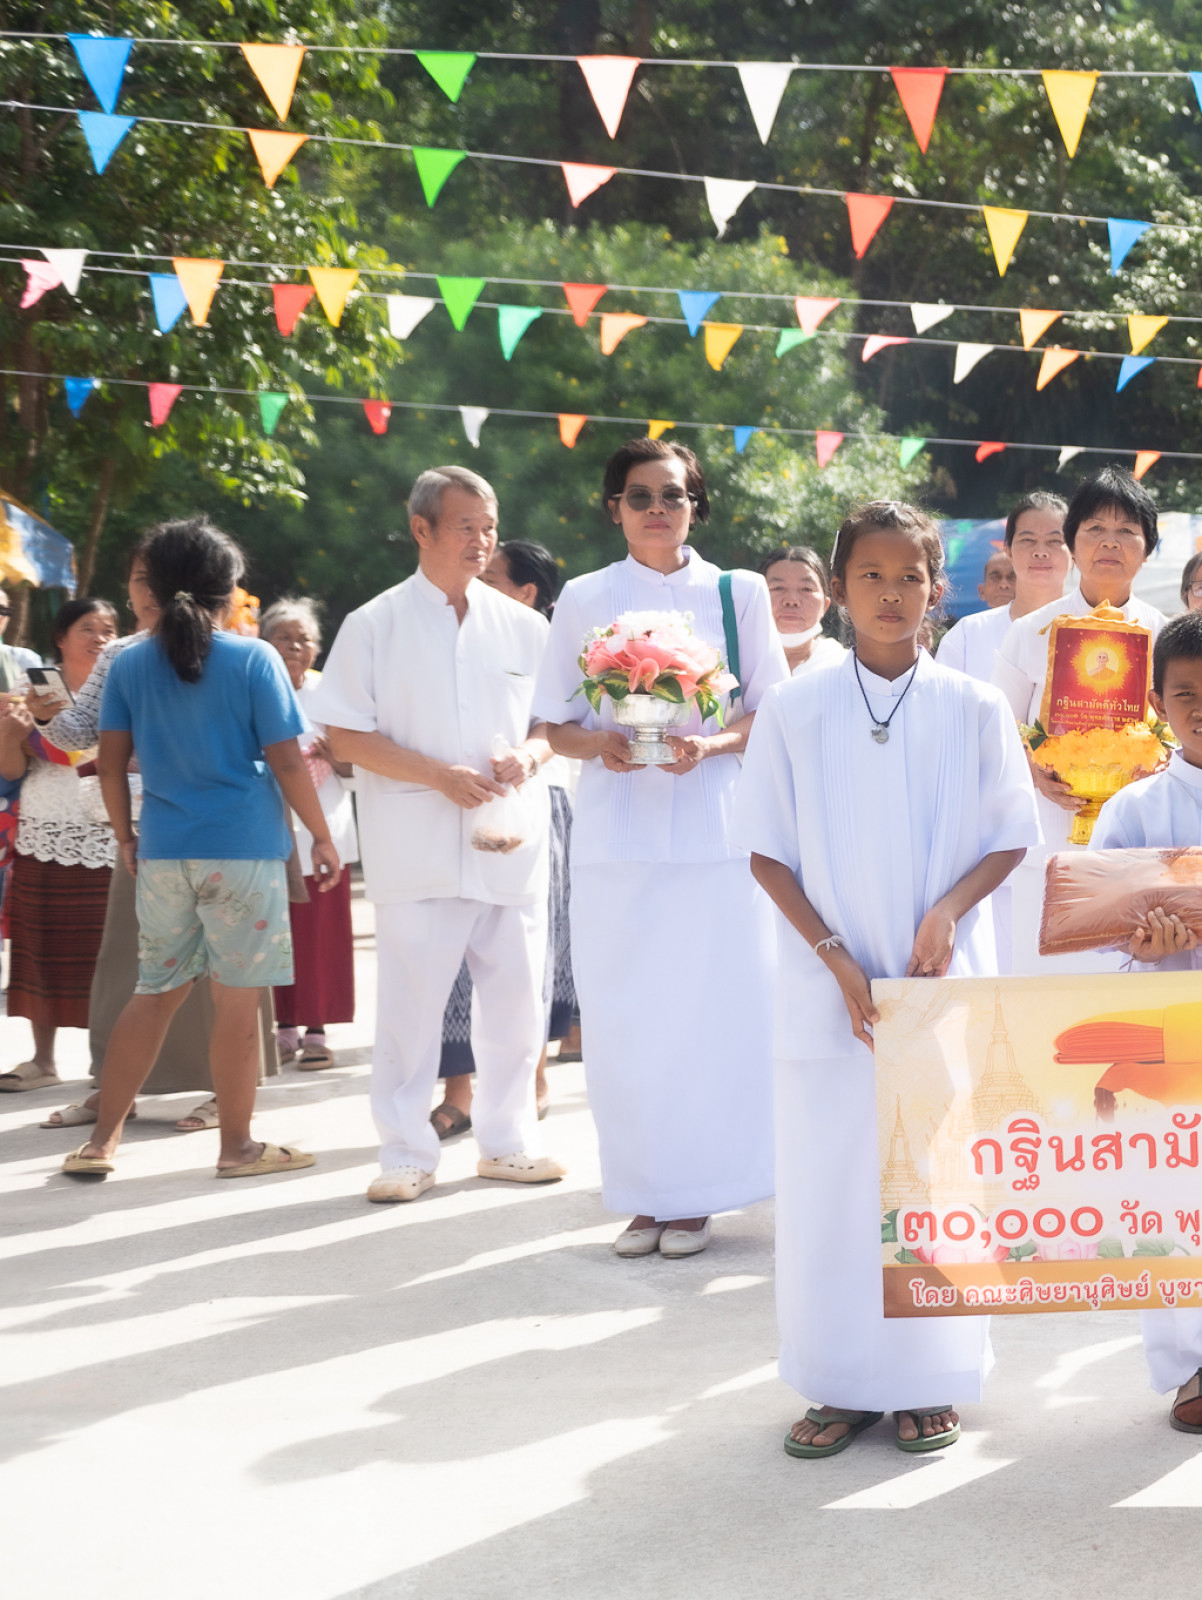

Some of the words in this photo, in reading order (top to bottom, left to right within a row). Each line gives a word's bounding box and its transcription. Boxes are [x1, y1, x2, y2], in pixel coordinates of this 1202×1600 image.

[904, 1206, 1103, 1248] ๓๐,๐๐๐
[1119, 1200, 1162, 1235] วัด
[911, 1280, 955, 1304] โดย
[965, 1273, 1149, 1307] คณะศิษยานุศิษย์
